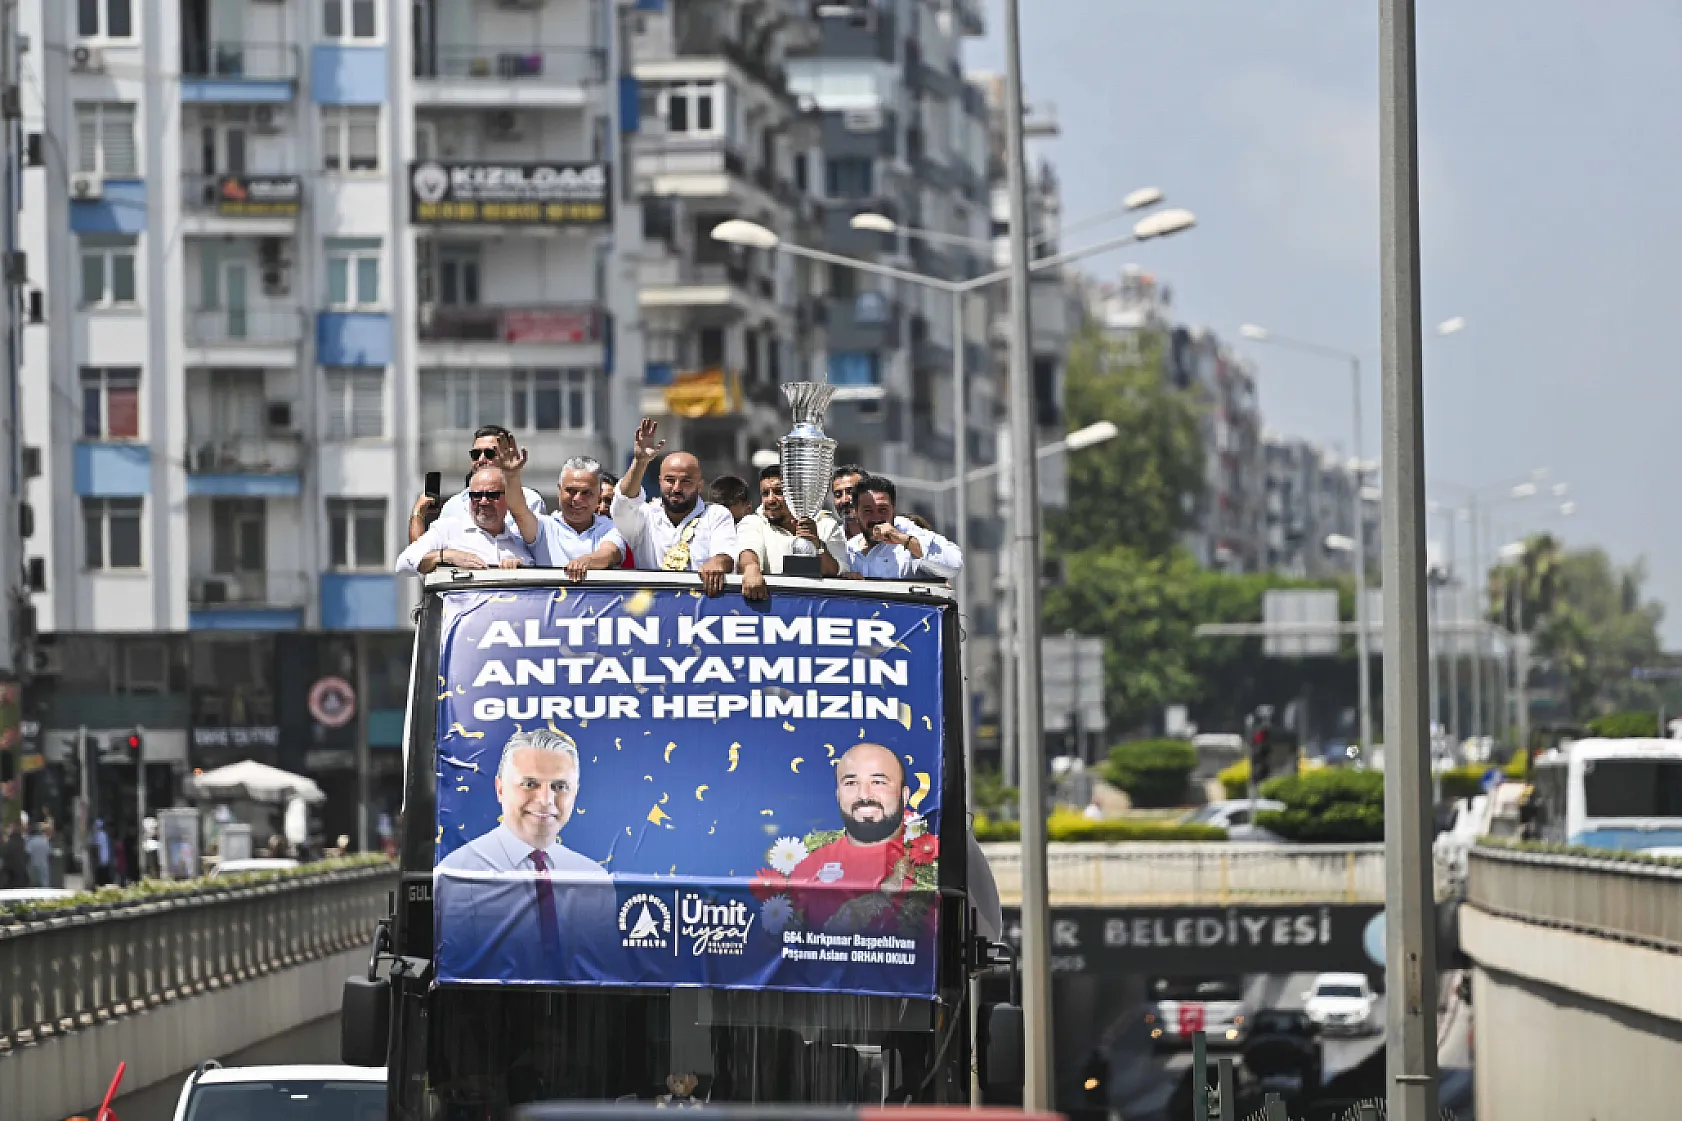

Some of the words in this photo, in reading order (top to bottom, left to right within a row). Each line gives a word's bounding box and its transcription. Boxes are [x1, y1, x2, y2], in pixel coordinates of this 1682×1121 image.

[477, 616, 660, 648] ALTIN
[676, 615, 898, 649] KEMER
[472, 655, 909, 687] ANTALYA'MIZIN
[473, 695, 641, 720] GURUR
[652, 688, 899, 721] HEPİMİZİN
[682, 893, 748, 926] Ümit
[806, 932, 852, 947] Kırkpınar
[1102, 906, 1332, 947] BELEDİYESİ
[622, 938, 667, 948] ANTALYA
[851, 950, 884, 964] ORHAN
[885, 952, 916, 965] OKULU
